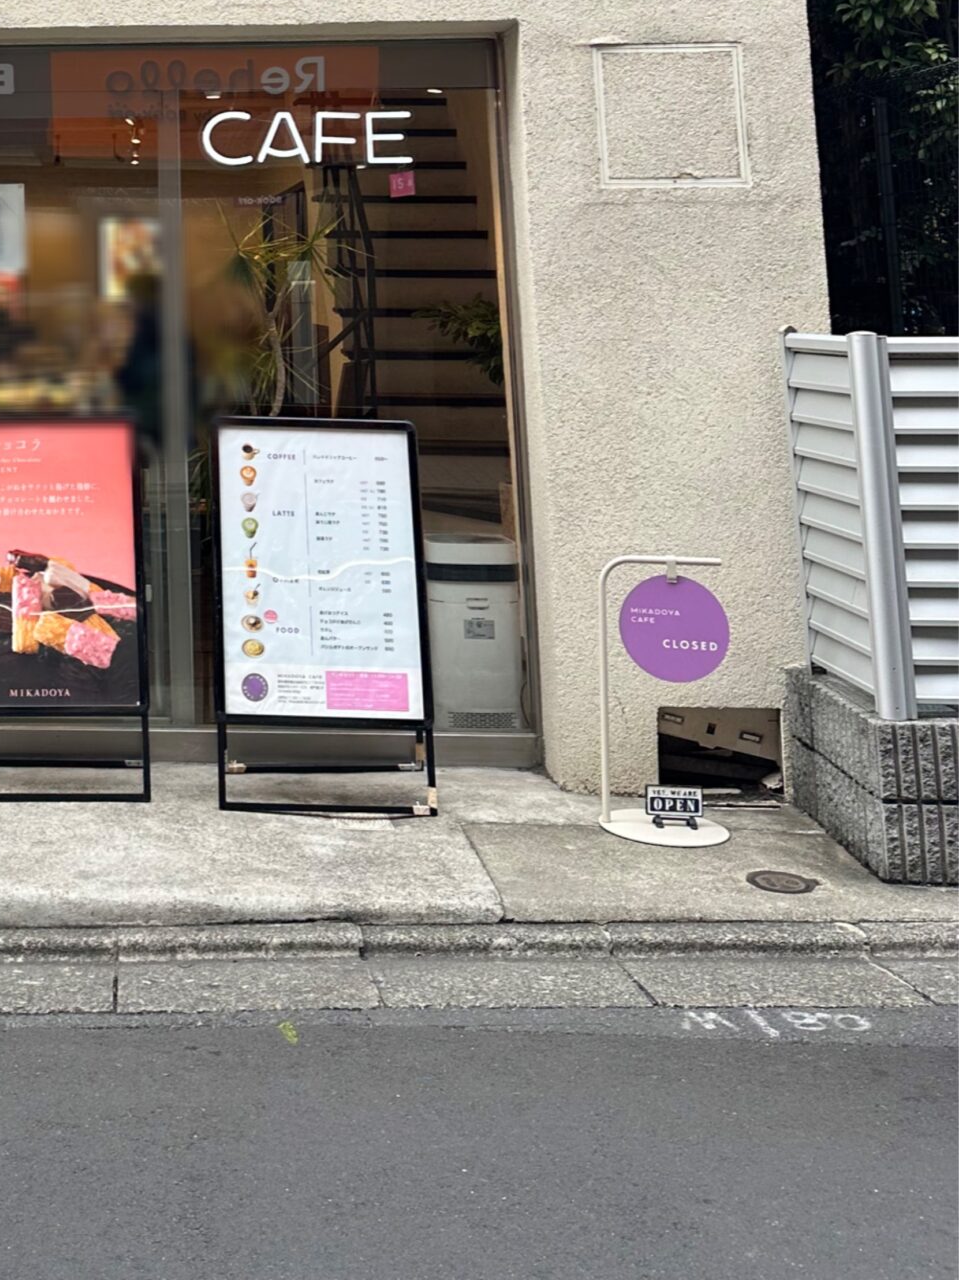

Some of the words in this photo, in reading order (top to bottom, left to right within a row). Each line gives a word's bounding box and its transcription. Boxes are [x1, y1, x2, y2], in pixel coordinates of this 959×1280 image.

[202, 111, 414, 165] CAFE
[630, 607, 681, 616] MIKADOYA
[630, 616, 656, 624] CAFE
[662, 638, 719, 652] CLOSED
[9, 688, 71, 698] MIKADOYA
[653, 797, 696, 812] OPEN
